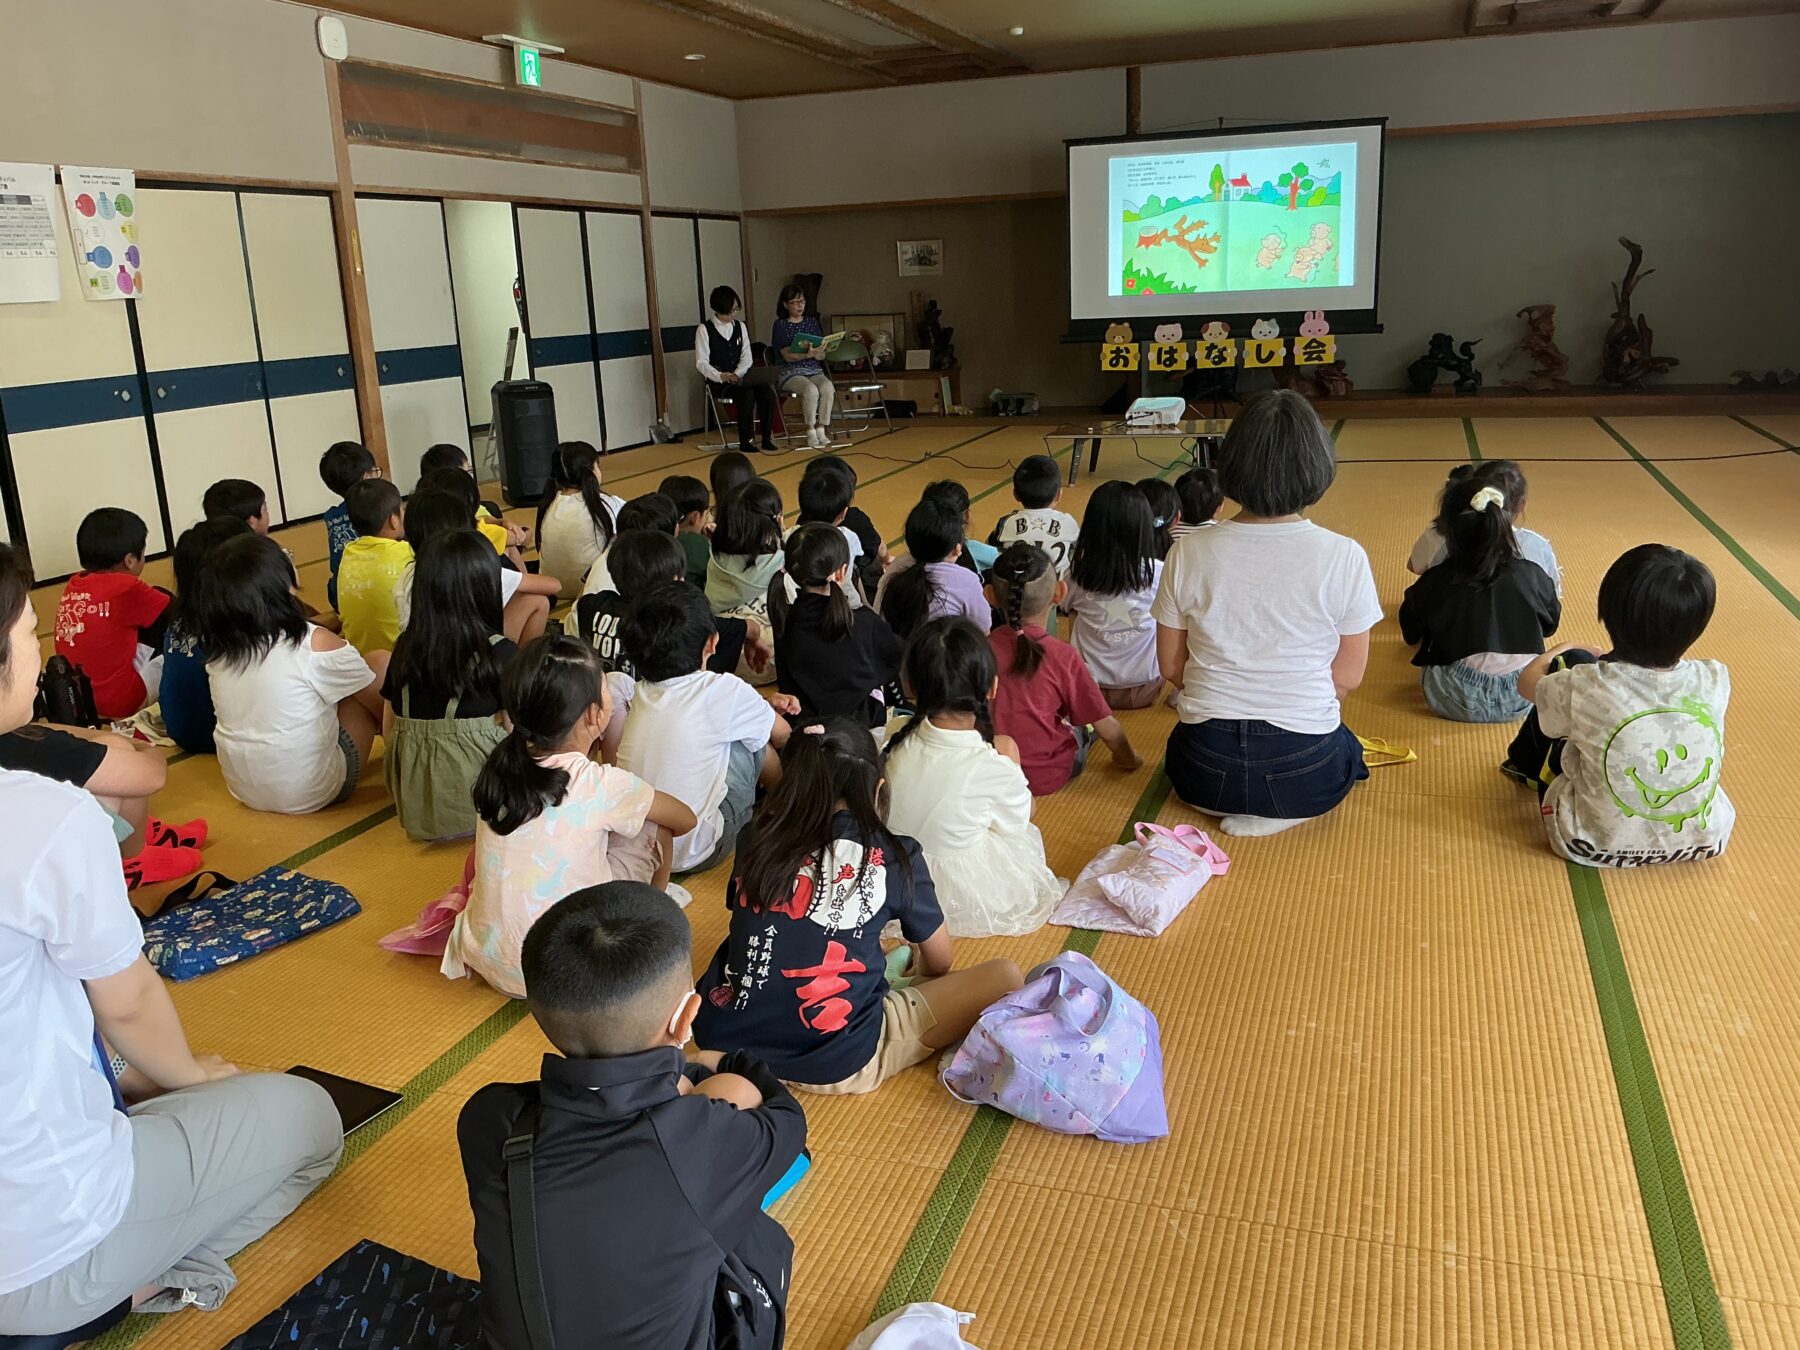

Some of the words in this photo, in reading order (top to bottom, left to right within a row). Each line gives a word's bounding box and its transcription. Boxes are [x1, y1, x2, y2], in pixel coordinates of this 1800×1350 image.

[1108, 338, 1327, 368] おはなし会
[1016, 518, 1029, 536] B
[1046, 518, 1061, 537] B
[1566, 838, 1722, 867] Simplify
[756, 924, 779, 990] 全員野球で
